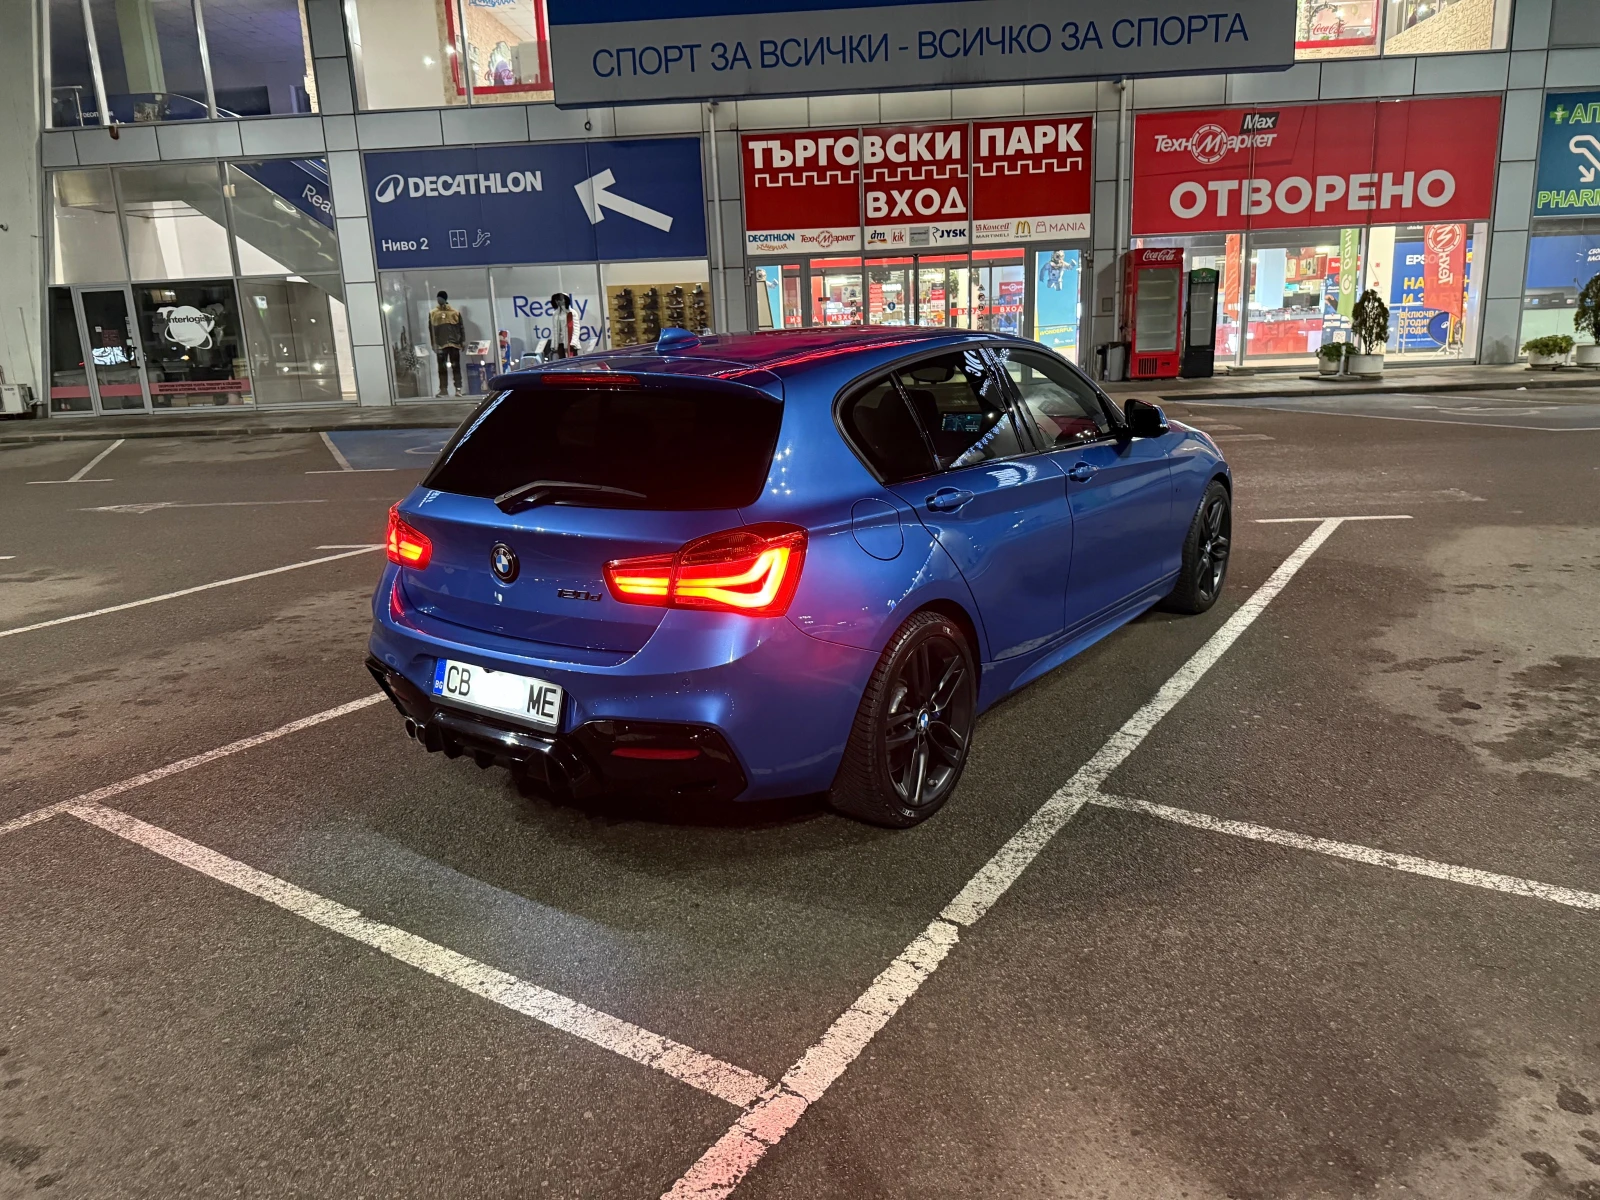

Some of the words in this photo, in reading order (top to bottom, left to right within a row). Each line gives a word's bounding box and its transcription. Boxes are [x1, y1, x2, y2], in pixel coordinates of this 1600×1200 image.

[593, 44, 702, 77] СПОРТ
[711, 41, 752, 72] ЗА
[760, 33, 889, 69] ВСИЧКИ
[918, 23, 1051, 60] ВСИЧКО
[1061, 21, 1103, 51] ЗА
[1112, 13, 1249, 48] СПОРТА
[1243, 114, 1276, 130] Max
[748, 131, 961, 169] ТЪРГОВСКИ
[980, 123, 1084, 157] ПАРК
[407, 171, 543, 198] DECATHLON
[302, 184, 333, 215] Rea
[1169, 169, 1456, 219] ОТВОРЕНО
[866, 187, 966, 218] ВХОД
[939, 229, 967, 238] JYSK
[1049, 222, 1086, 232] MANIA
[748, 233, 795, 243] DECATHLON
[870, 230, 885, 239] dm
[892, 231, 904, 242] kik
[382, 240, 417, 252] Ниво
[419, 238, 429, 250] 2
[1000, 304, 1023, 313] ВХОД
[533, 325, 551, 339] to
[557, 588, 603, 602] 120d
[434, 679, 444, 690] BG
